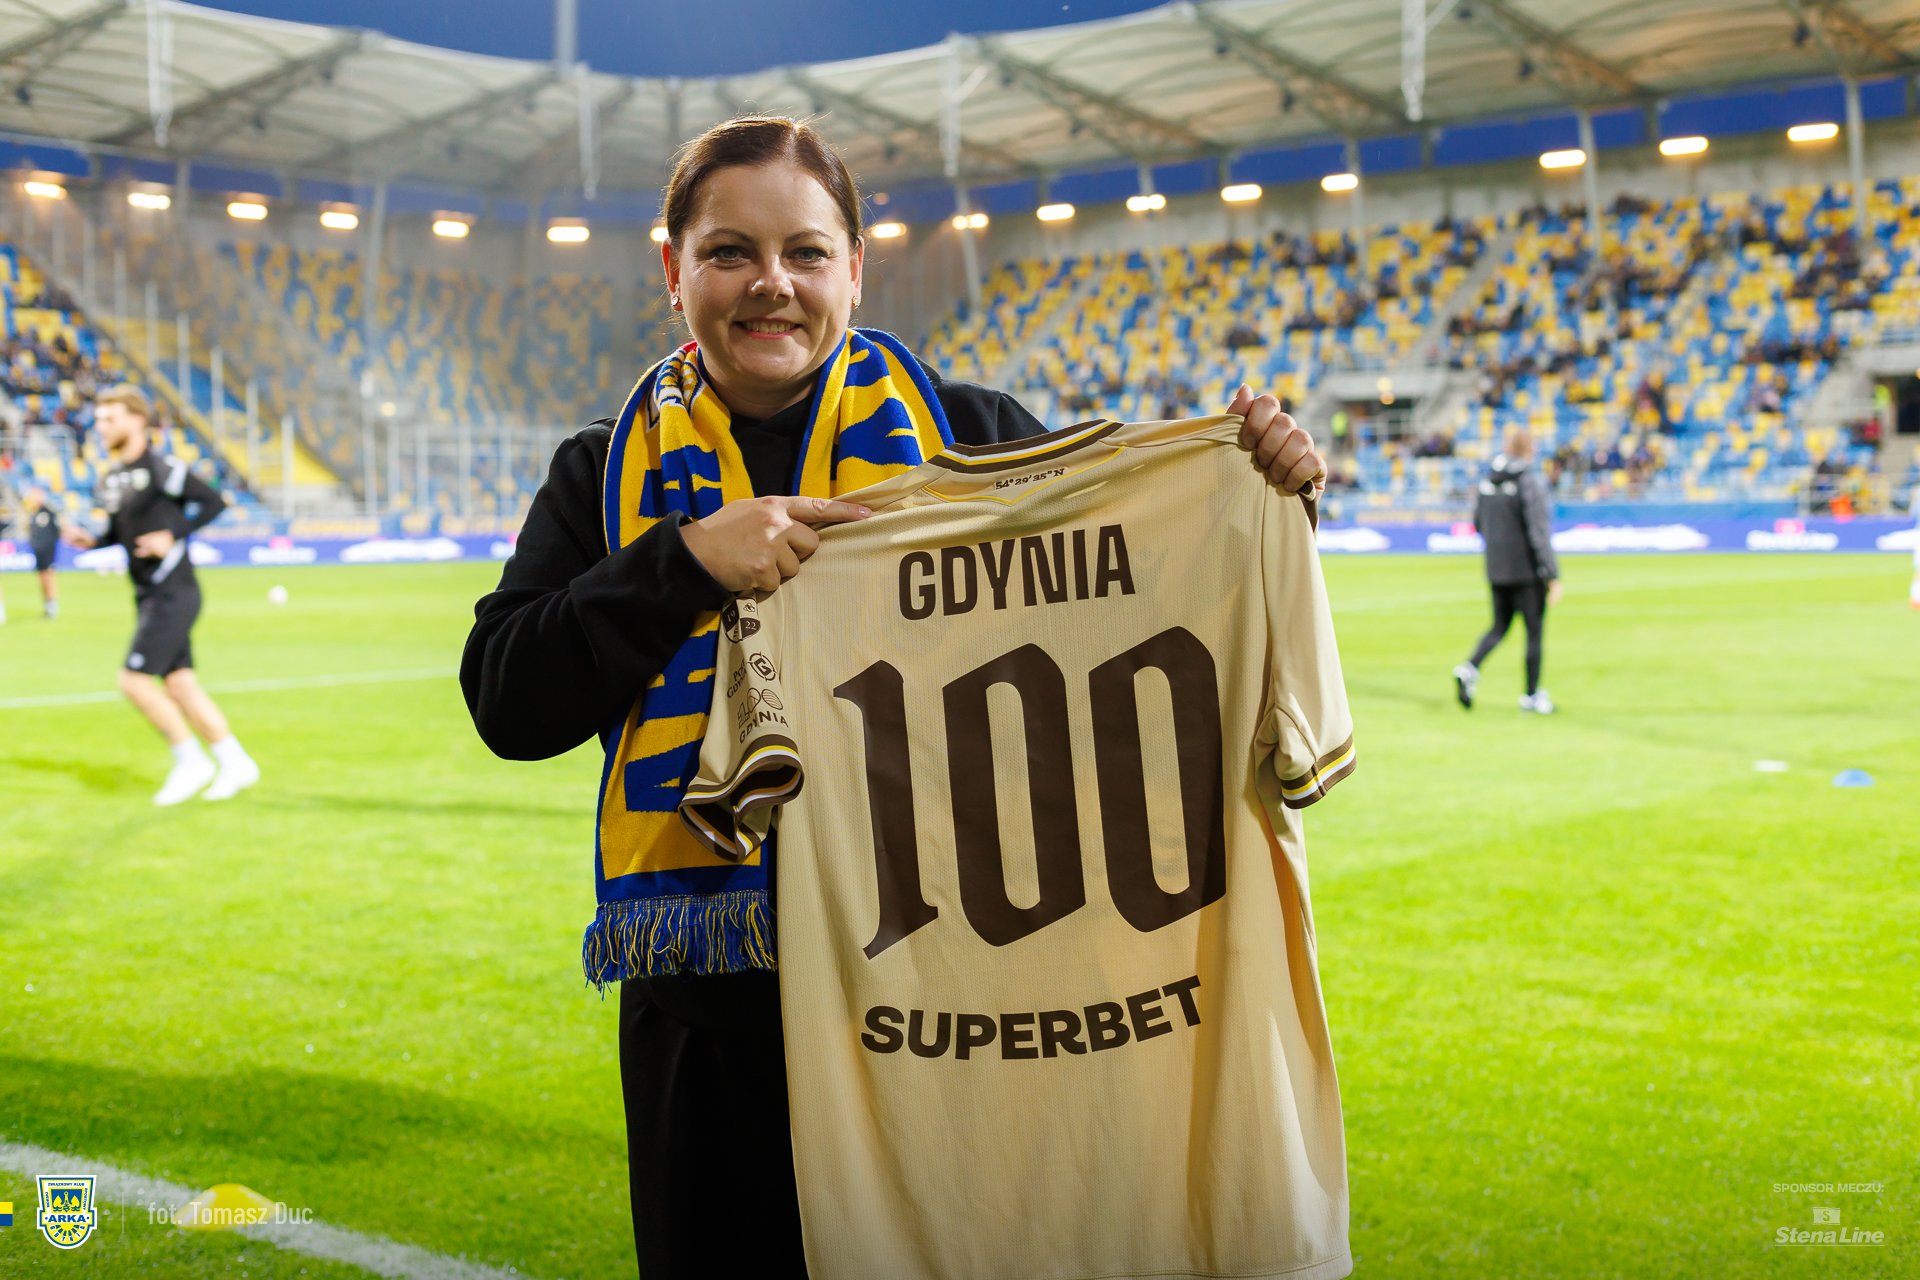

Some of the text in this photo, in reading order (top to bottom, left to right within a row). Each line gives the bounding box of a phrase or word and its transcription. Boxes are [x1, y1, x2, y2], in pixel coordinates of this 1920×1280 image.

[899, 524, 1136, 621] GDYNIA
[745, 620, 757, 631] 22
[739, 710, 790, 744] GDYNIA
[833, 625, 1227, 961] 100
[861, 975, 1202, 1061] SUPERBET
